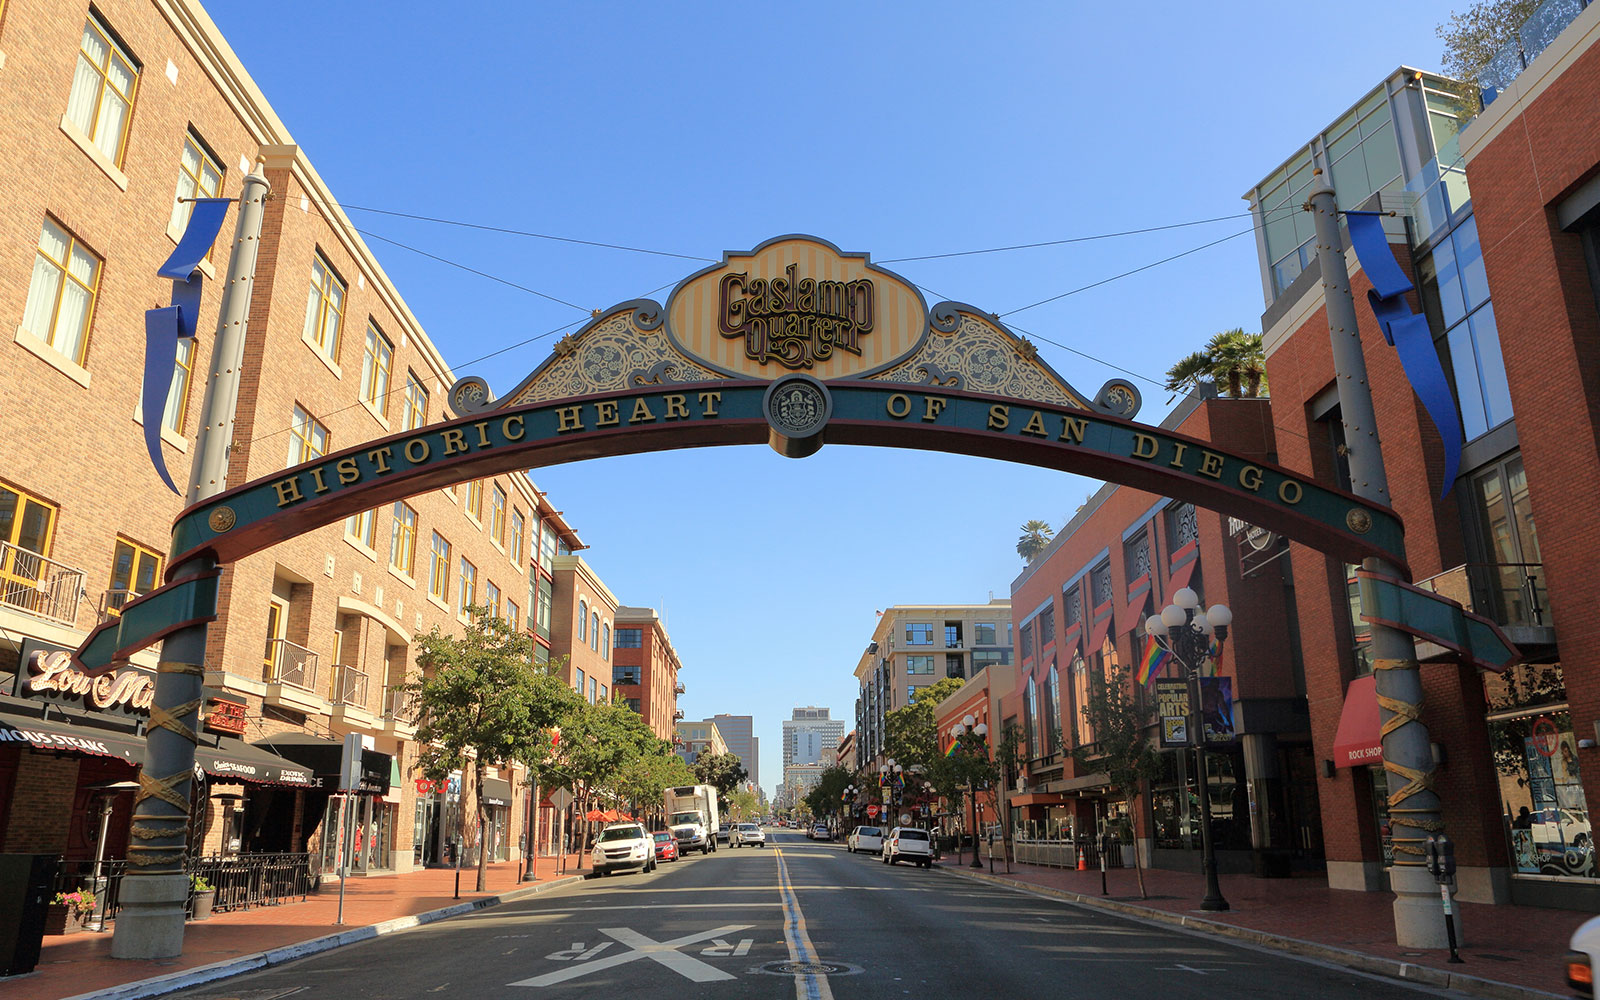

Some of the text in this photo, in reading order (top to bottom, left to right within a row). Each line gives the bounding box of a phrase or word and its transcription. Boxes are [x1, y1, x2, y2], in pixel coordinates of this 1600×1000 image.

[718, 262, 874, 339] Gaslamp
[744, 313, 862, 370] Quarter
[271, 413, 526, 508] HISTORIC
[556, 391, 723, 433] HEART
[886, 392, 947, 421] OF
[988, 404, 1090, 444] SAN
[1132, 432, 1304, 505] DIEGO
[27, 650, 92, 696] Lou
[1158, 693, 1189, 703] POPULAR
[1159, 702, 1190, 717] ARTS
[50, 734, 109, 754] STEAKS
[1348, 746, 1382, 761] ROCK SHOP
[231, 763, 256, 775] SEAFOOD
[281, 769, 305, 778] EXOTIC
[279, 775, 308, 783] DRINKS
